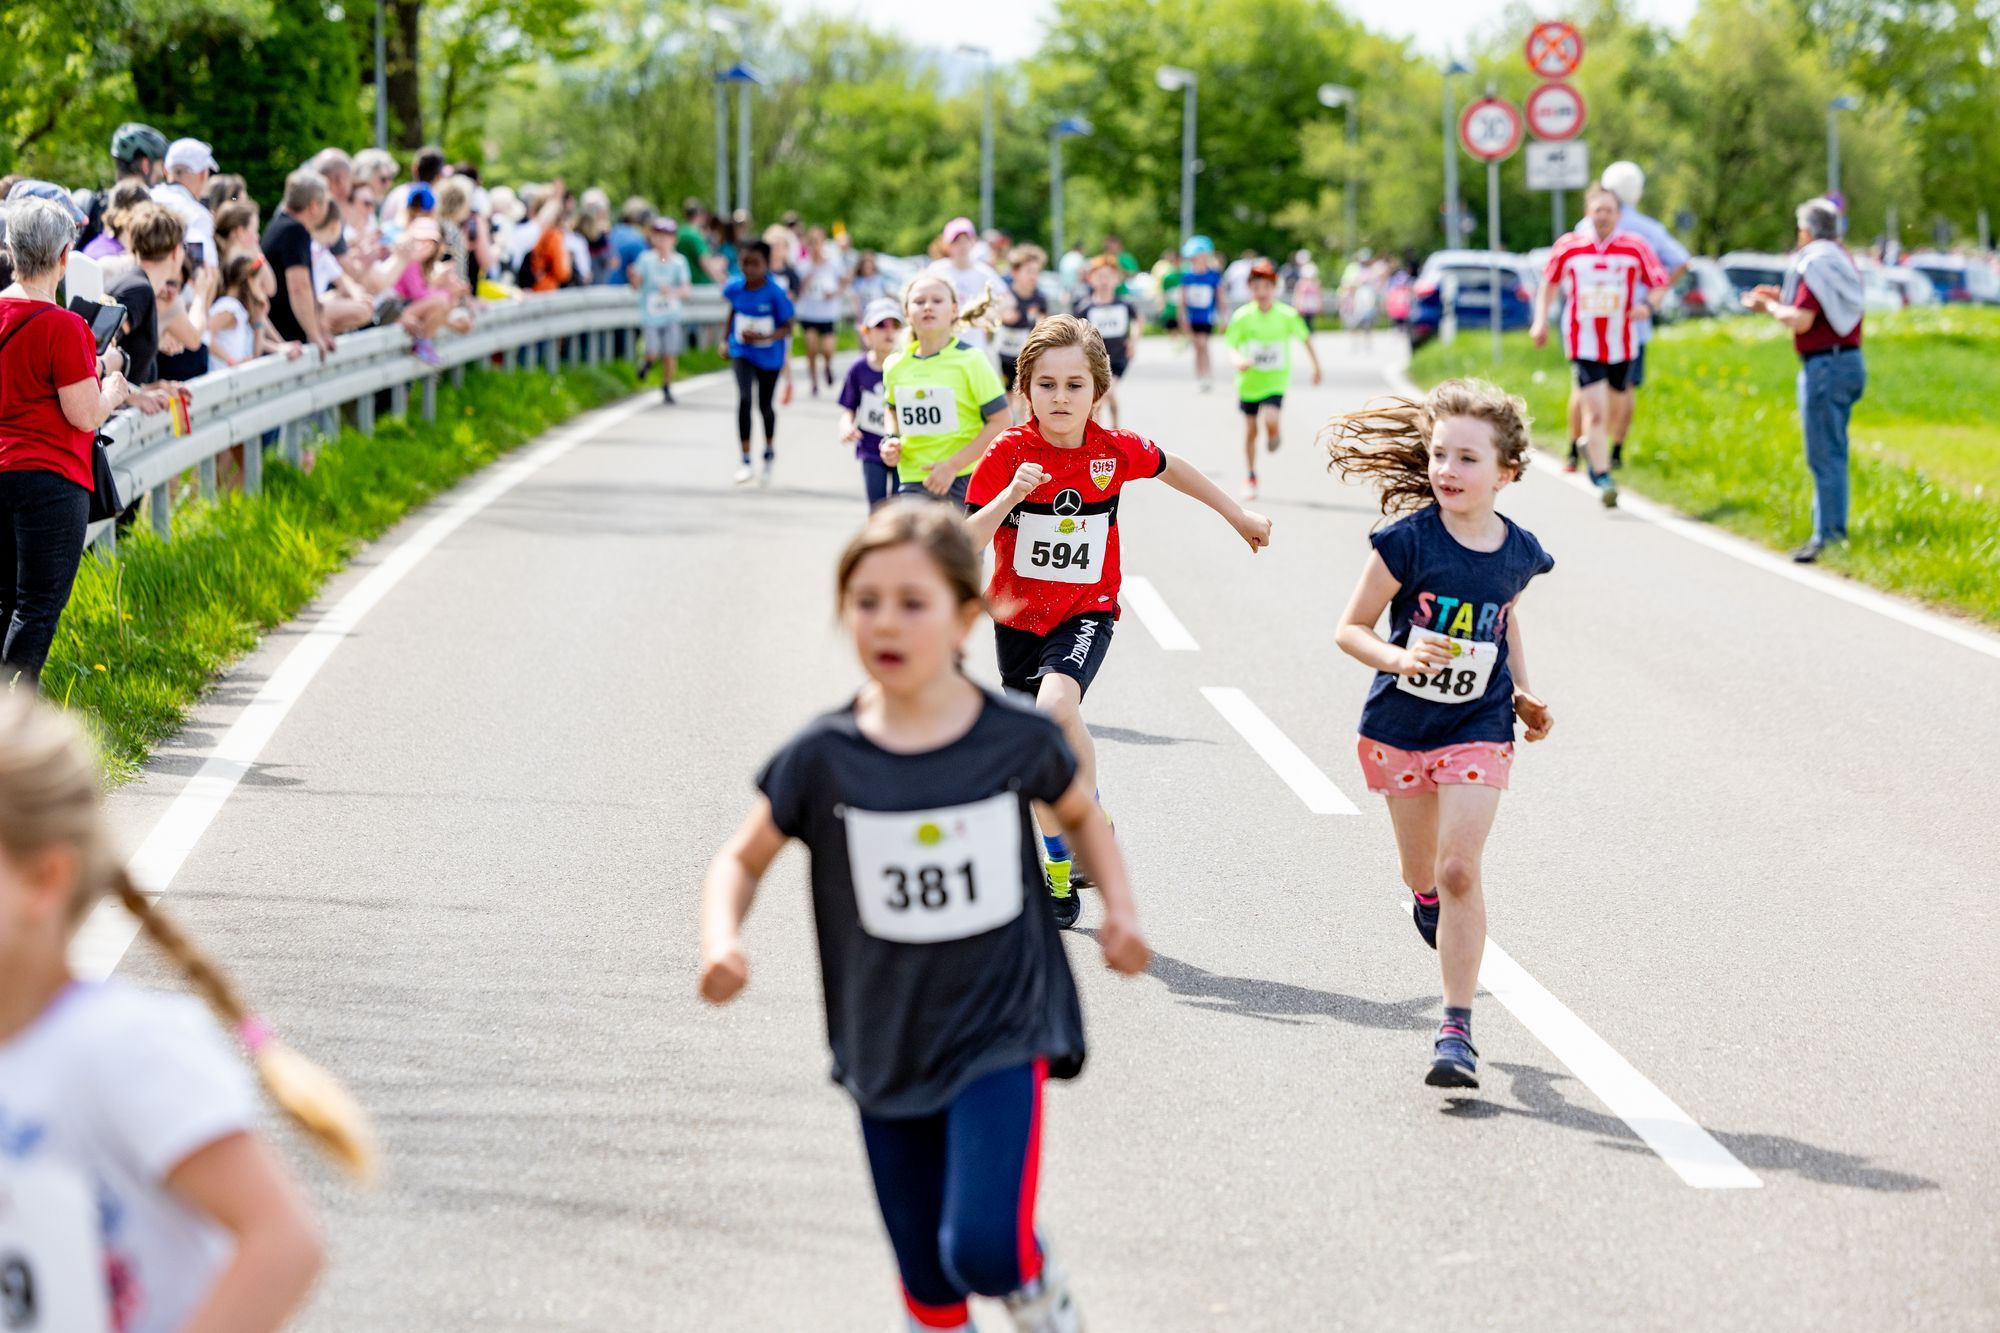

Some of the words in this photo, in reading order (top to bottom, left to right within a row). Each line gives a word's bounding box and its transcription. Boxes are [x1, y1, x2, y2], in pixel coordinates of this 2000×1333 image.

[903, 406, 941, 425] 580
[1031, 541, 1090, 570] 594
[883, 859, 977, 911] 381
